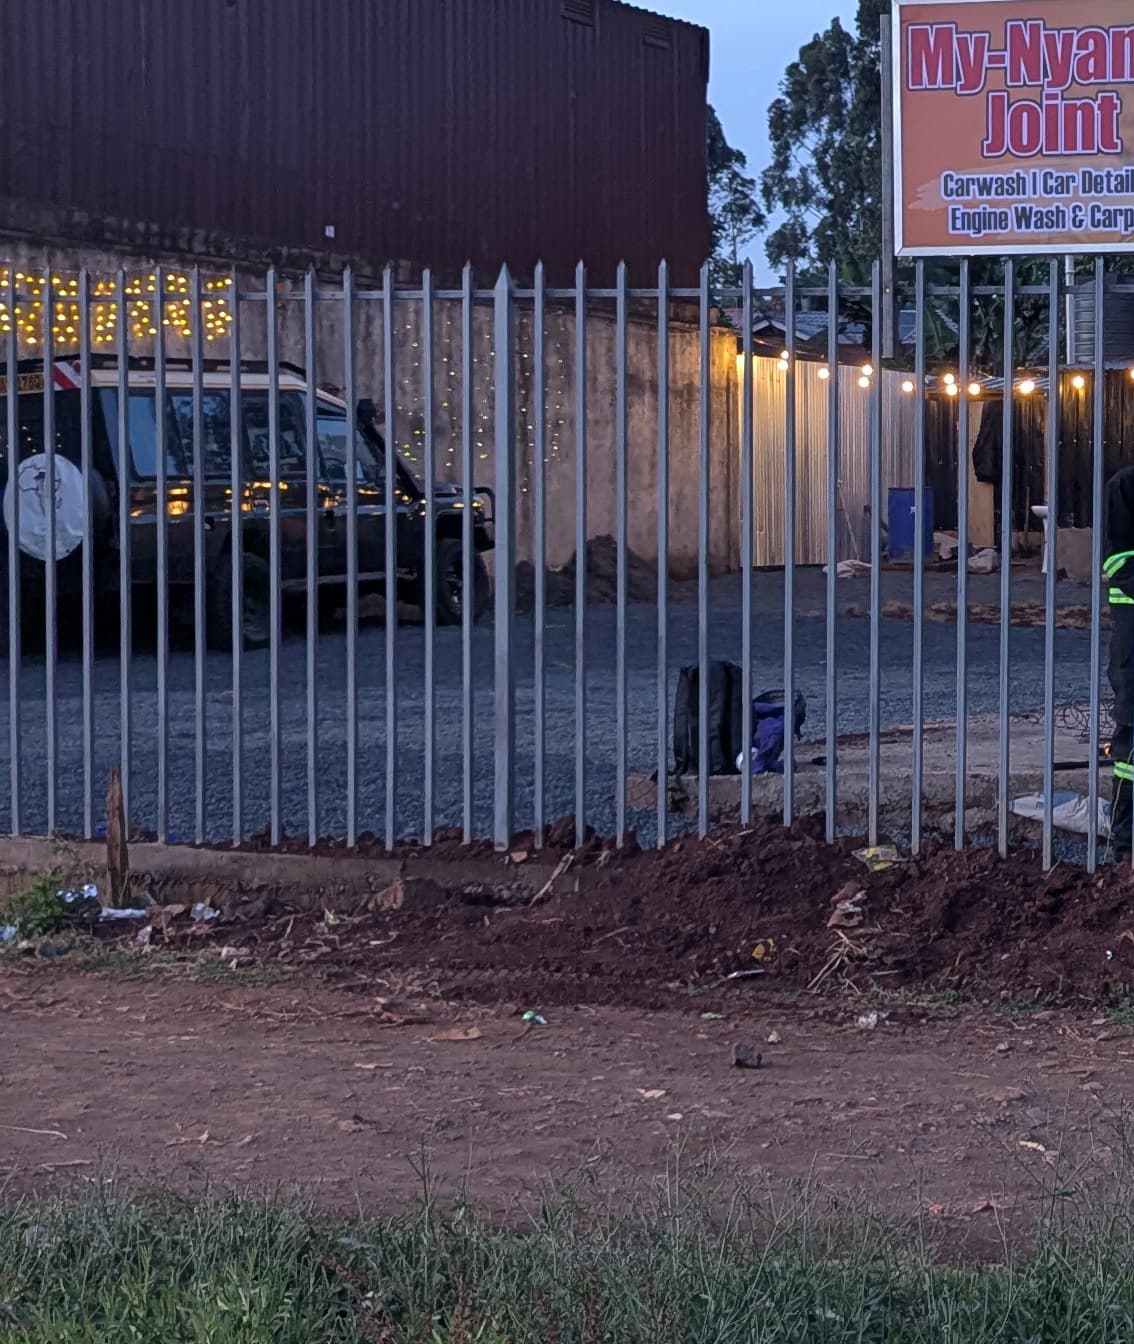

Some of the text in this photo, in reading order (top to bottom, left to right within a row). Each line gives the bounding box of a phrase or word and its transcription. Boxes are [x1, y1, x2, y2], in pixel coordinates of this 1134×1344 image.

[983, 91, 1122, 157] Joint
[942, 172, 1027, 198] Carwash
[1042, 170, 1076, 195] Car
[951, 206, 1009, 234] Engine
[1014, 204, 1066, 230] Wash
[1071, 204, 1086, 229] &
